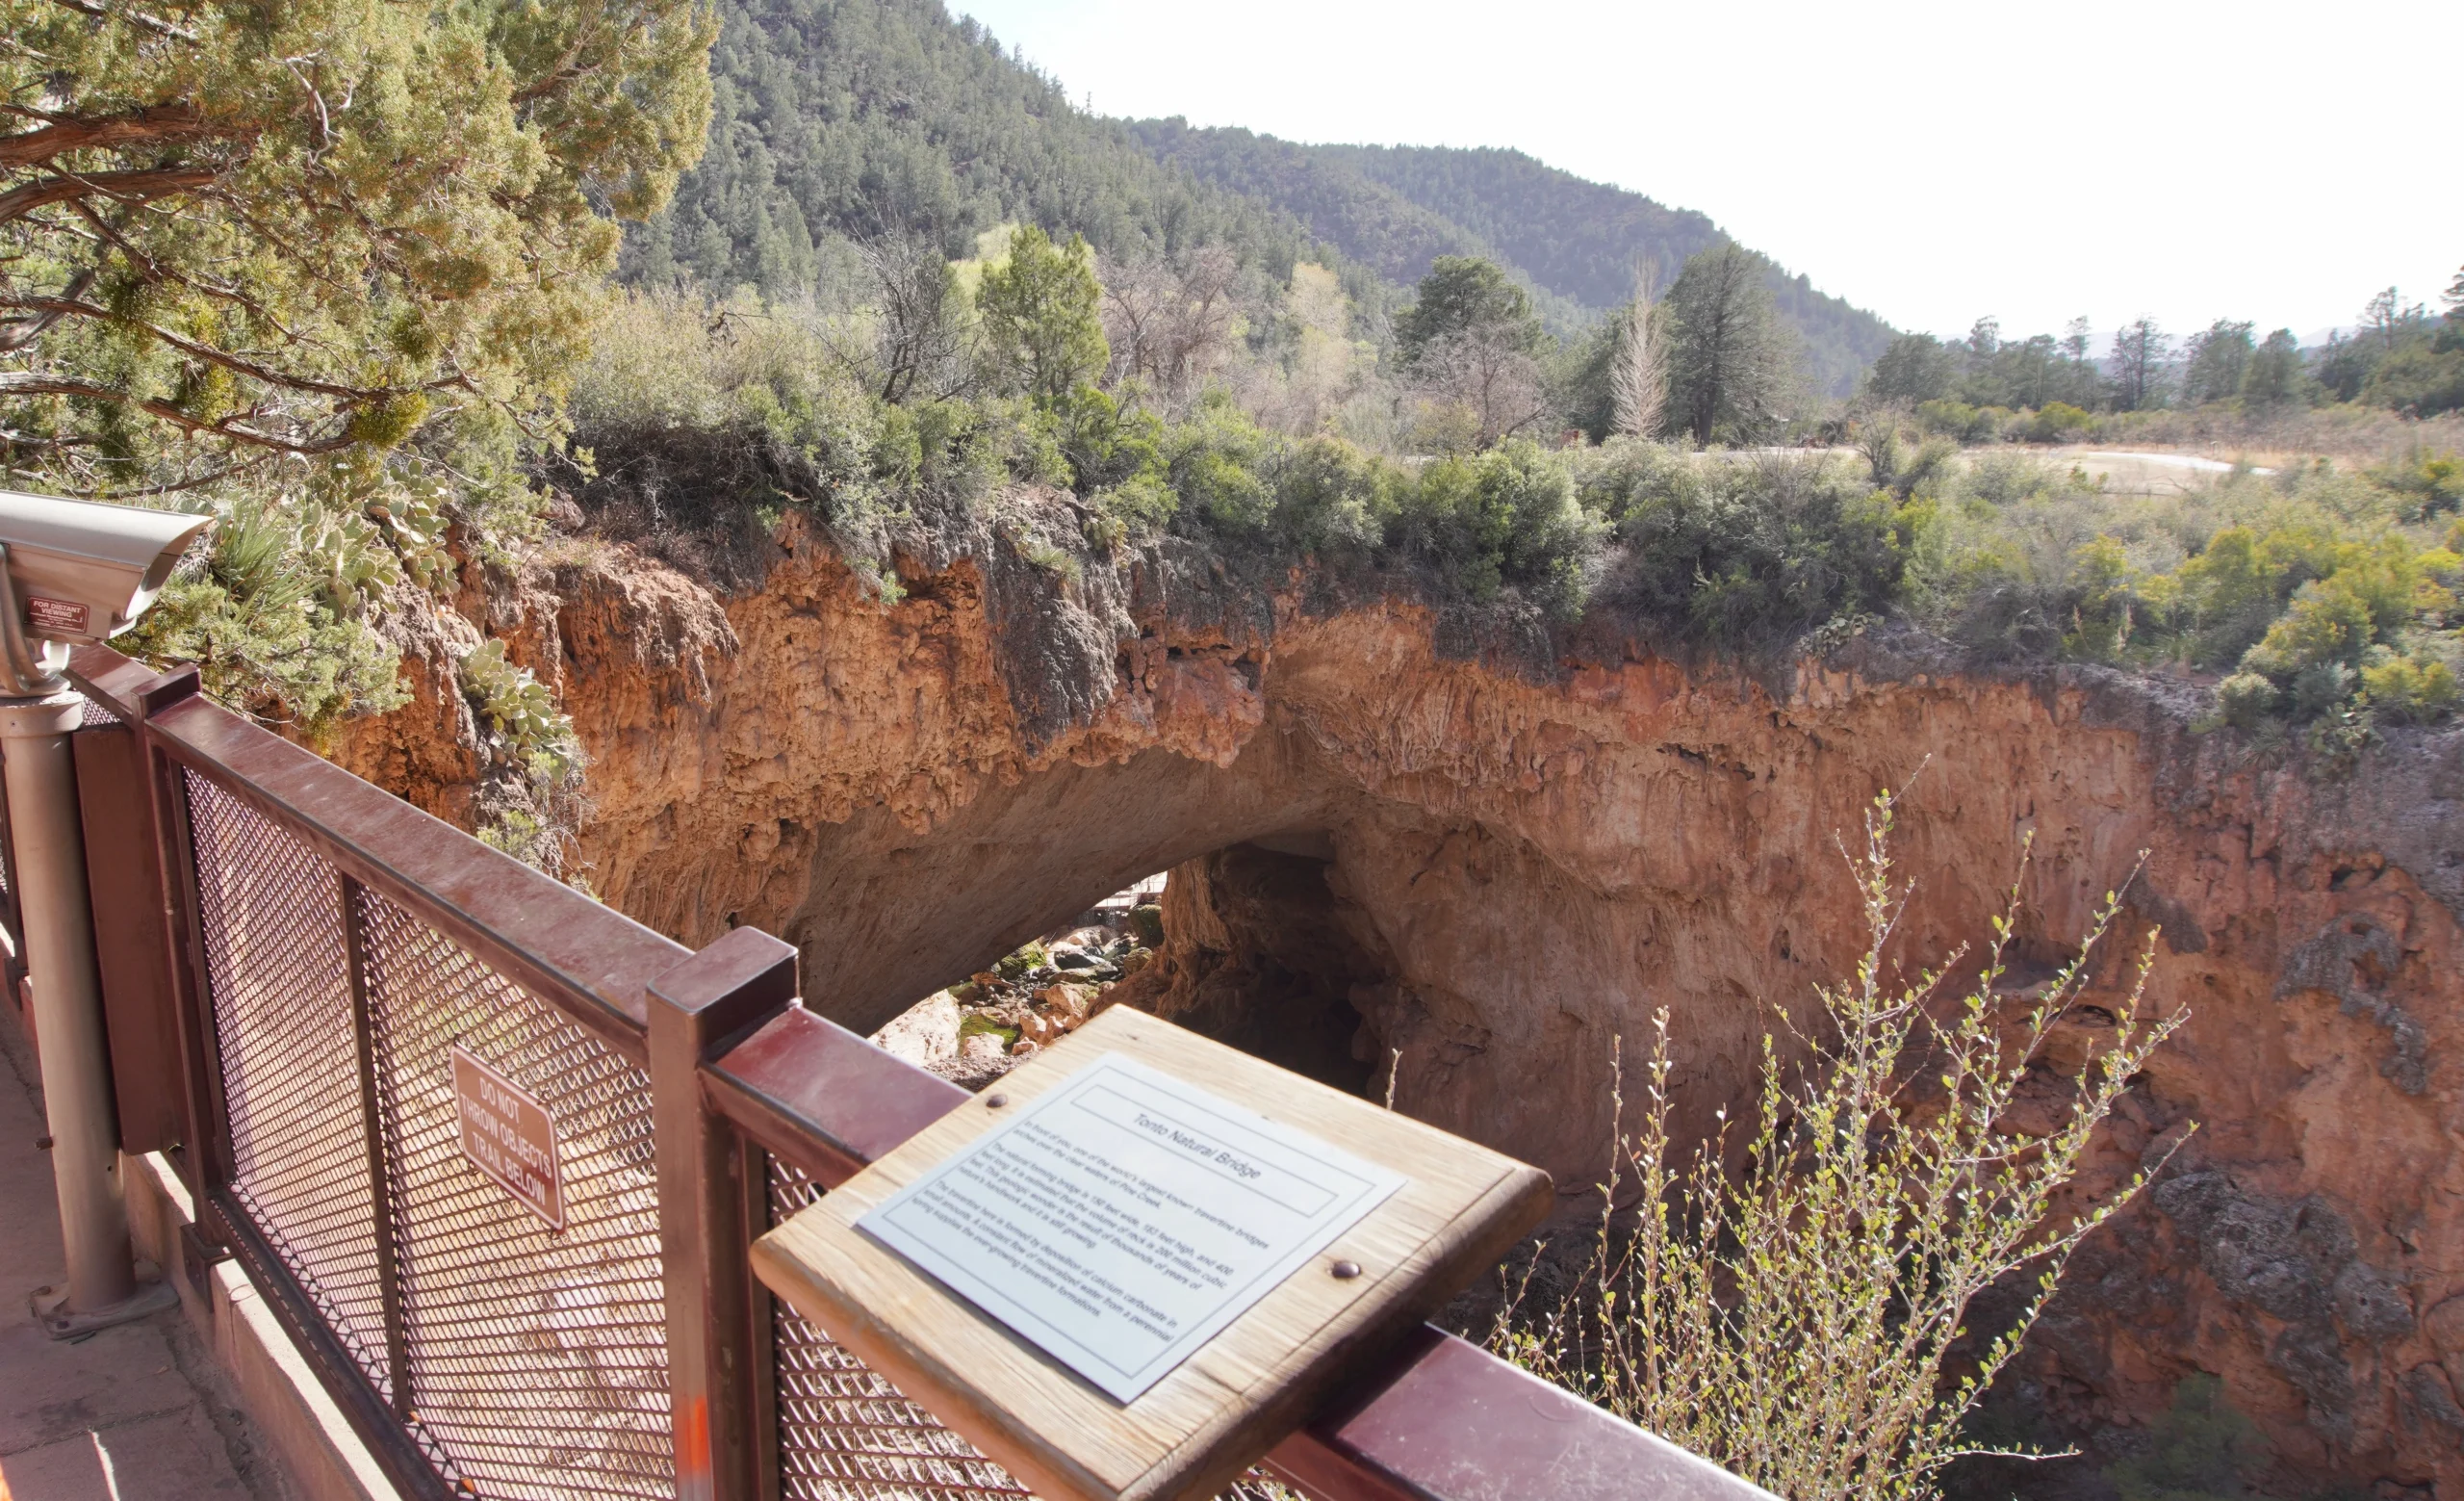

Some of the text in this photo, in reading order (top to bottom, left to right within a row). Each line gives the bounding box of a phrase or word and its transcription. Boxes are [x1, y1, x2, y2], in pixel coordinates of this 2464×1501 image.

[41, 608, 72, 617] VIEWING
[51, 604, 81, 613] DISTANT
[460, 1093, 553, 1178] THROW OBJECTS
[480, 1077, 520, 1124] DO NOT
[473, 1131, 546, 1205] TRAIL BELOW
[1013, 1128, 1160, 1208] arches over the clear waters of Pine Creek.
[1023, 1119, 1032, 1127] In
[1032, 1124, 1050, 1135] front
[1073, 1147, 1088, 1155] one
[1096, 1157, 1110, 1167] the
[1138, 1178, 1167, 1196] largest
[1166, 1193, 1194, 1208] known
[1194, 1206, 1235, 1230] travertine
[1235, 1228, 1269, 1249] bridges
[1134, 1113, 1261, 1178] Tonto Natural Bridge
[911, 1196, 934, 1213] spring
[933, 1209, 962, 1229] supplies
[962, 1227, 974, 1236] the
[973, 1235, 1020, 1267] ever-growing
[1019, 1263, 1057, 1288] travertine
[981, 1150, 994, 1159] feet
[1024, 1176, 1060, 1196] estimated
[1059, 1194, 1076, 1204] that
[1074, 1202, 1088, 1211] the
[1089, 1210, 1116, 1228] volume
[1128, 1231, 1145, 1244] rock
[1171, 1256, 1201, 1274] million
[1201, 1274, 1226, 1288] cubic
[986, 1165, 999, 1177] This
[997, 1176, 1027, 1194] geologic
[1030, 1193, 1057, 1208] wonder
[1065, 1211, 1078, 1222] the
[1080, 1220, 1102, 1234] result
[1110, 1237, 1153, 1264] thousands
[1153, 1261, 1167, 1270] of
[1163, 1268, 1188, 1283] years
[1189, 1281, 1202, 1291] of
[992, 1141, 1005, 1152] The
[1005, 1151, 1030, 1165] natural
[1030, 1163, 1057, 1181] forming
[1057, 1178, 1081, 1193] bridge
[1104, 1203, 1120, 1214] feet
[1158, 1231, 1175, 1244] feet
[1196, 1255, 1216, 1265] and
[1019, 1203, 1036, 1212] and
[1035, 1208, 1042, 1217] it
[1048, 1219, 1065, 1229] still
[923, 1189, 943, 1202] small
[978, 1224, 1011, 1244] constant
[1010, 1241, 1025, 1253] flow
[1025, 1251, 1038, 1259] of
[1035, 1257, 1080, 1285] mineralized
[1080, 1284, 1102, 1299] water
[1102, 1297, 1123, 1312] from
[1129, 1315, 1173, 1341] perennial
[936, 1179, 949, 1191] The
[948, 1188, 981, 1209] travertine
[980, 1206, 996, 1220] here
[1004, 1222, 1032, 1240] formed
[1029, 1237, 1040, 1247] by
[1040, 1245, 1081, 1269] deposition
[1081, 1267, 1093, 1277] of
[1091, 1275, 1123, 1296] calcium
[1123, 1295, 1167, 1321] carbonate
[1166, 1319, 1177, 1328] in
